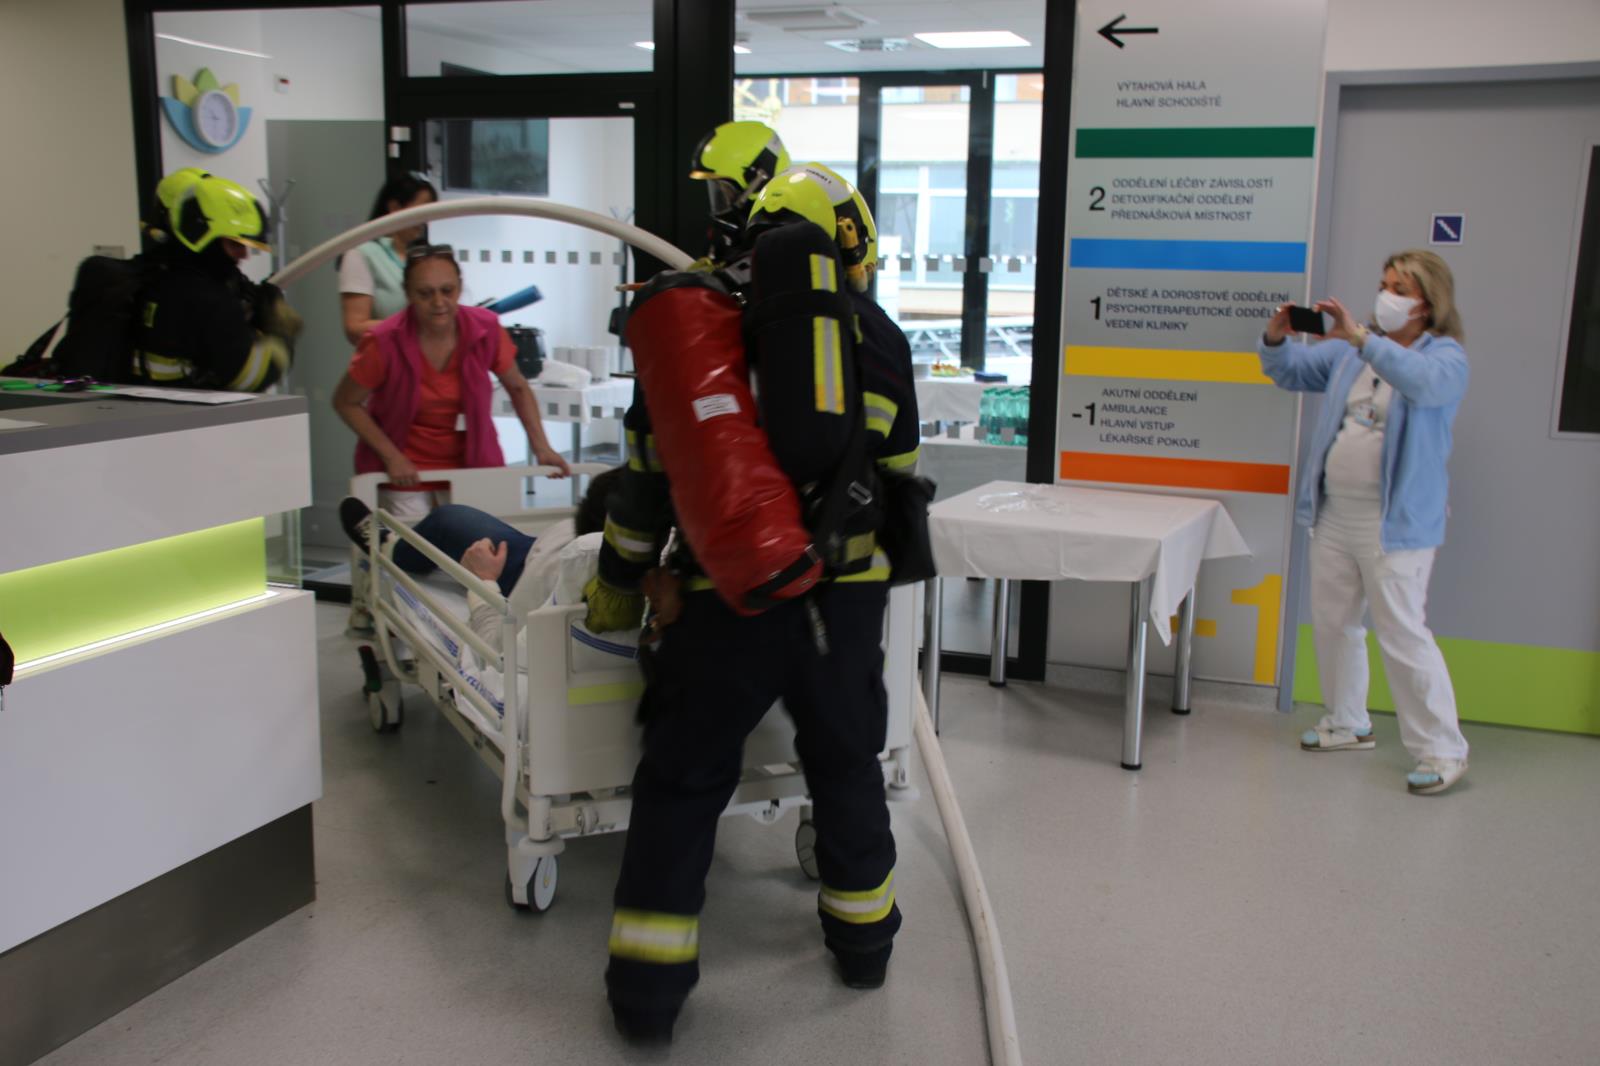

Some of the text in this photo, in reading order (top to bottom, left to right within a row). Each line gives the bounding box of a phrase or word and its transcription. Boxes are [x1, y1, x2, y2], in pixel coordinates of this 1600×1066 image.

[1177, 80, 1206, 91] HALA
[1117, 97, 1155, 108] HLAVNÍ
[1112, 177, 1167, 188] ODDĚLENÍ
[1089, 186, 1105, 211] 2
[1197, 193, 1254, 205] ODDĚLENÍ
[1107, 287, 1289, 303] DĚTSKÉ A DOROSTOVÉ ODDĚLENÍ
[1090, 296, 1101, 320] 1
[1106, 304, 1274, 318] PSYCHOTERAPEUTICKÉ ODDĚL
[1105, 320, 1188, 330] VEDENÍ KLINIKY
[1102, 388, 1198, 402] AKUTNÍ ODDĚLENÍ
[1072, 402, 1095, 425] -1
[1101, 403, 1168, 416] AMBULANCE
[1101, 419, 1175, 431] HLAVNÍ VSTUP
[1158, 436, 1201, 449] POKOJE
